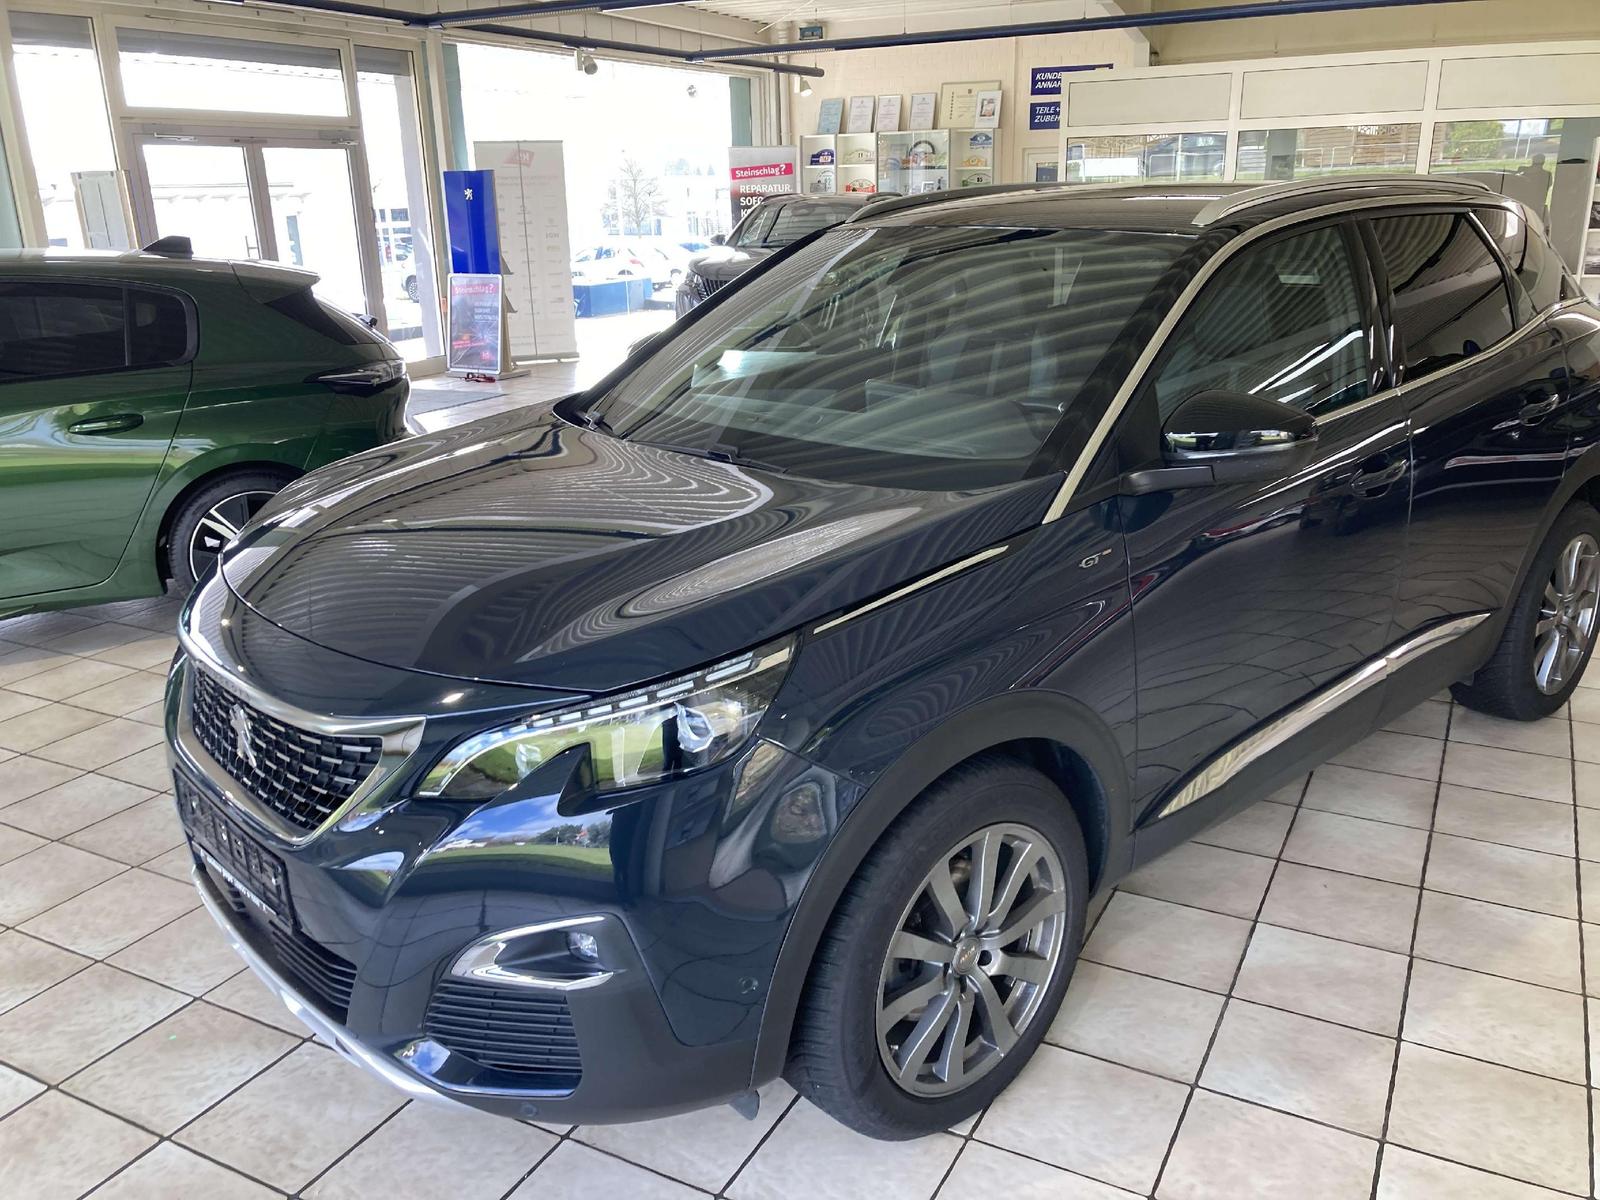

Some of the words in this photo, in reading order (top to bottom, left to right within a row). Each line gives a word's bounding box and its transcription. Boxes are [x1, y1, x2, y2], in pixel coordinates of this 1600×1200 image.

[1036, 106, 1055, 114] TEILE
[736, 164, 786, 178] Steinschlag?
[740, 183, 793, 193] REPARATUR.
